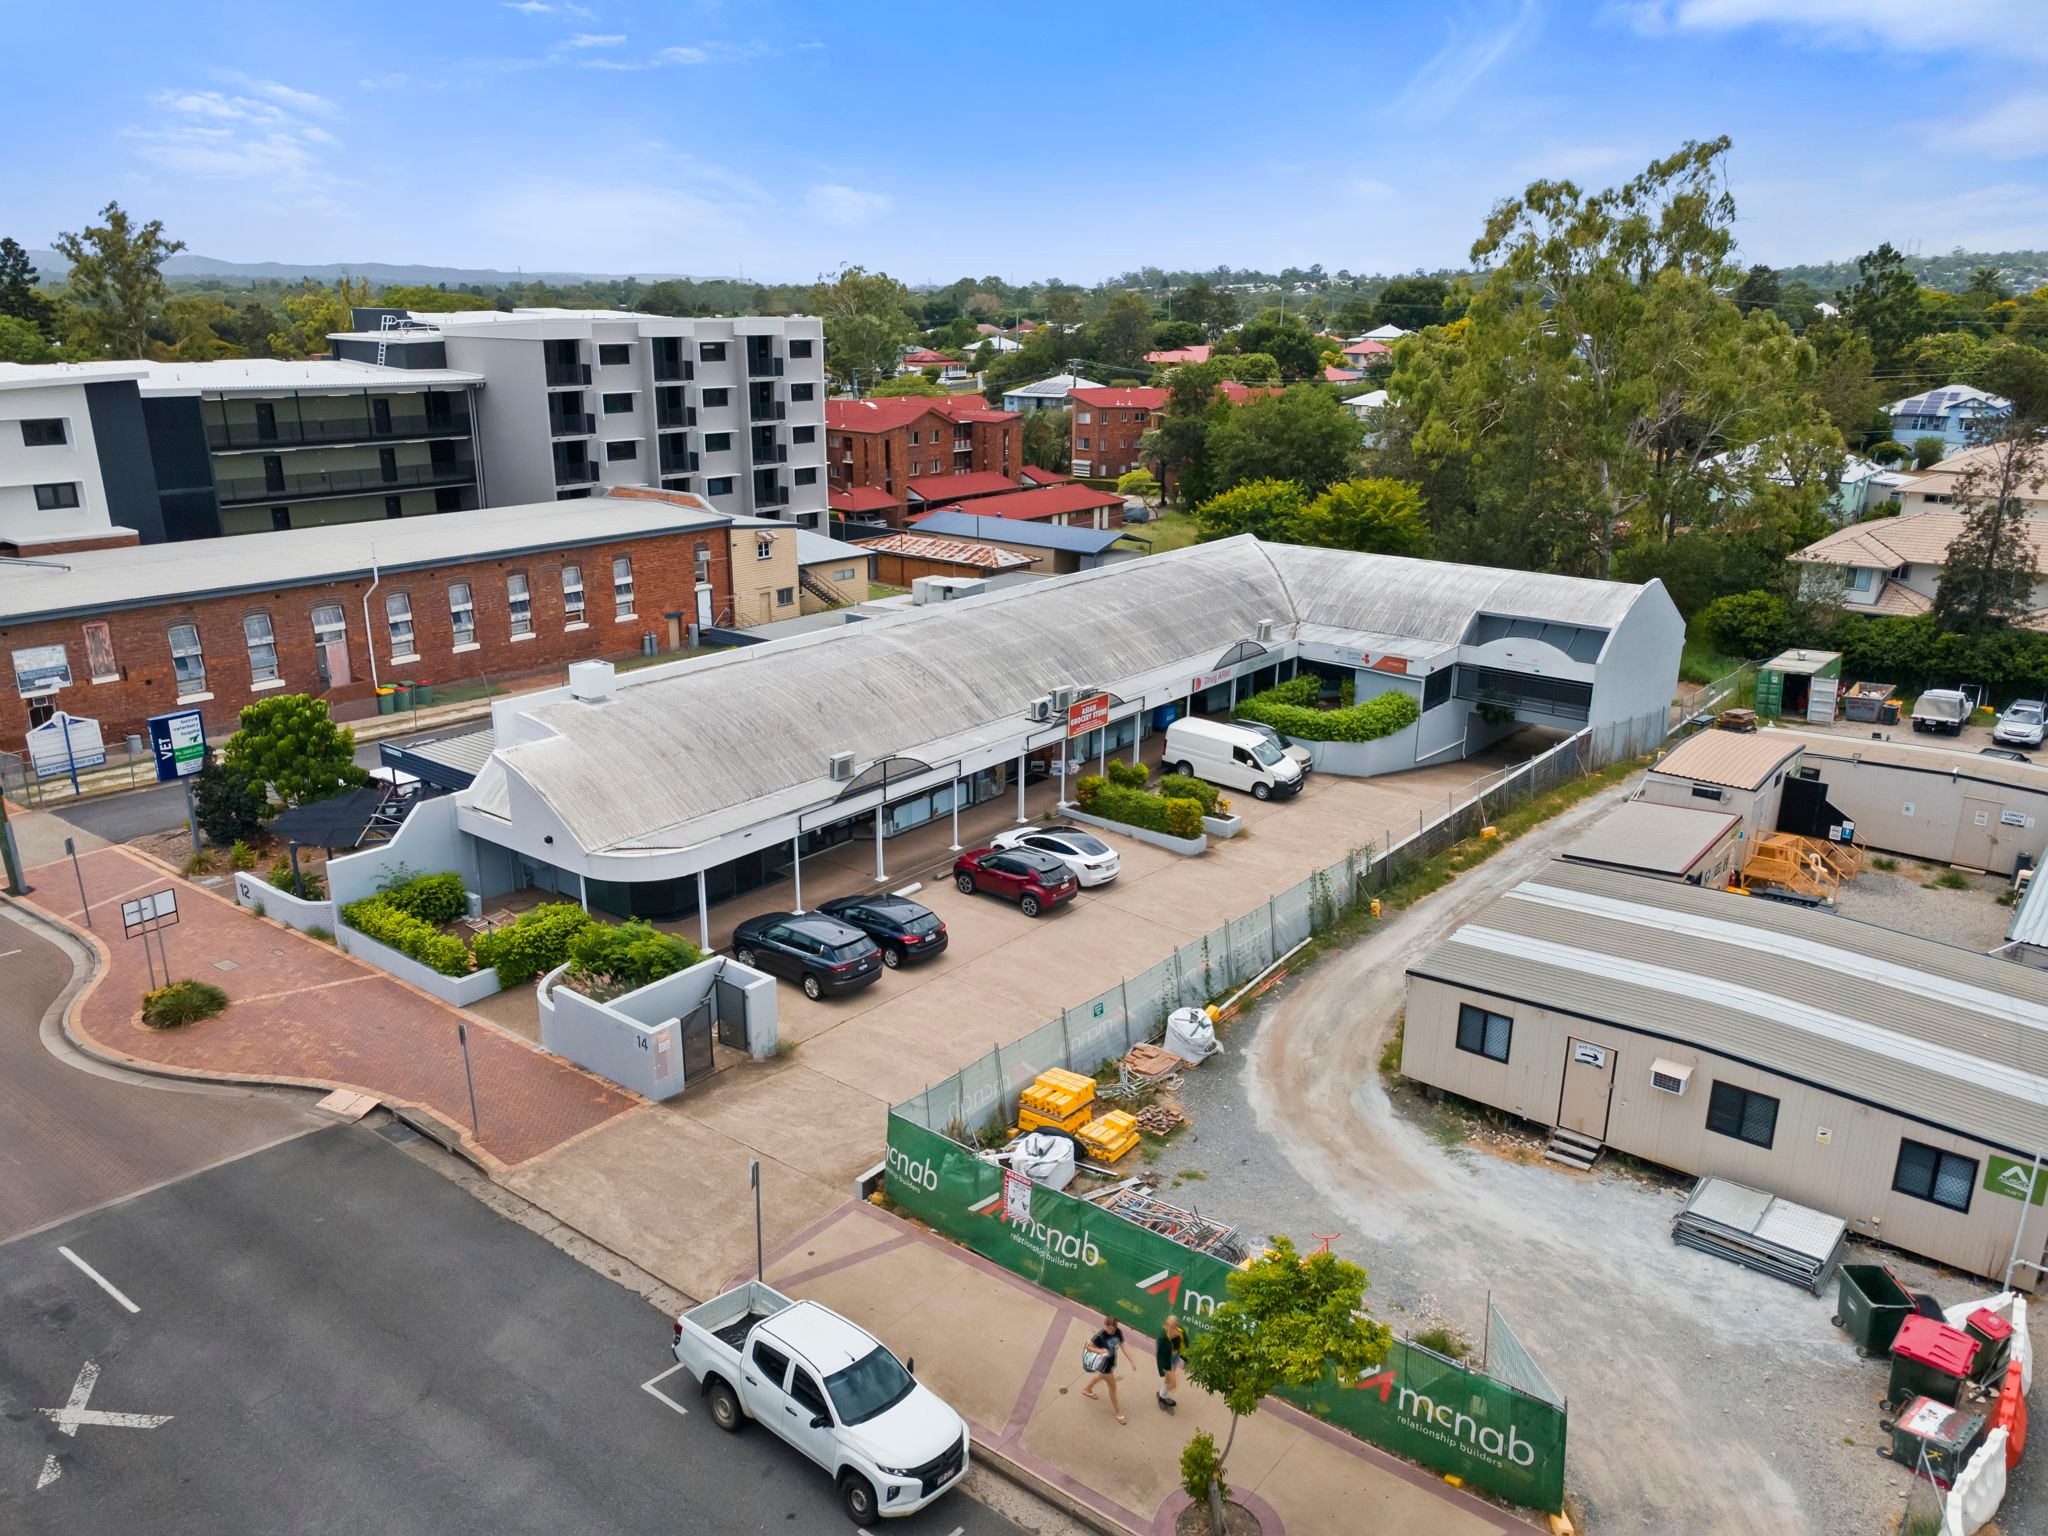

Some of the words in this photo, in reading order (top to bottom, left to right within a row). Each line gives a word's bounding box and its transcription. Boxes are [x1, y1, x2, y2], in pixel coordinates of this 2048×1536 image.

[1204, 676, 1217, 684] Drug
[1217, 670, 1230, 680] ARM
[1071, 714, 1092, 726] GROCERY
[1092, 708, 1108, 718] STORE
[1082, 704, 1096, 714] ASIAN
[158, 738, 173, 760] VET
[239, 884, 251, 899] 12
[637, 1035, 648, 1051] 14
[1006, 1171, 1031, 1185] WARNING
[1010, 1232, 1045, 1257] relationship
[1045, 1252, 1078, 1270] builders
[1398, 1387, 1534, 1466] mcnab
[1397, 1414, 1456, 1447] relationship
[1460, 1443, 1502, 1468] builders
